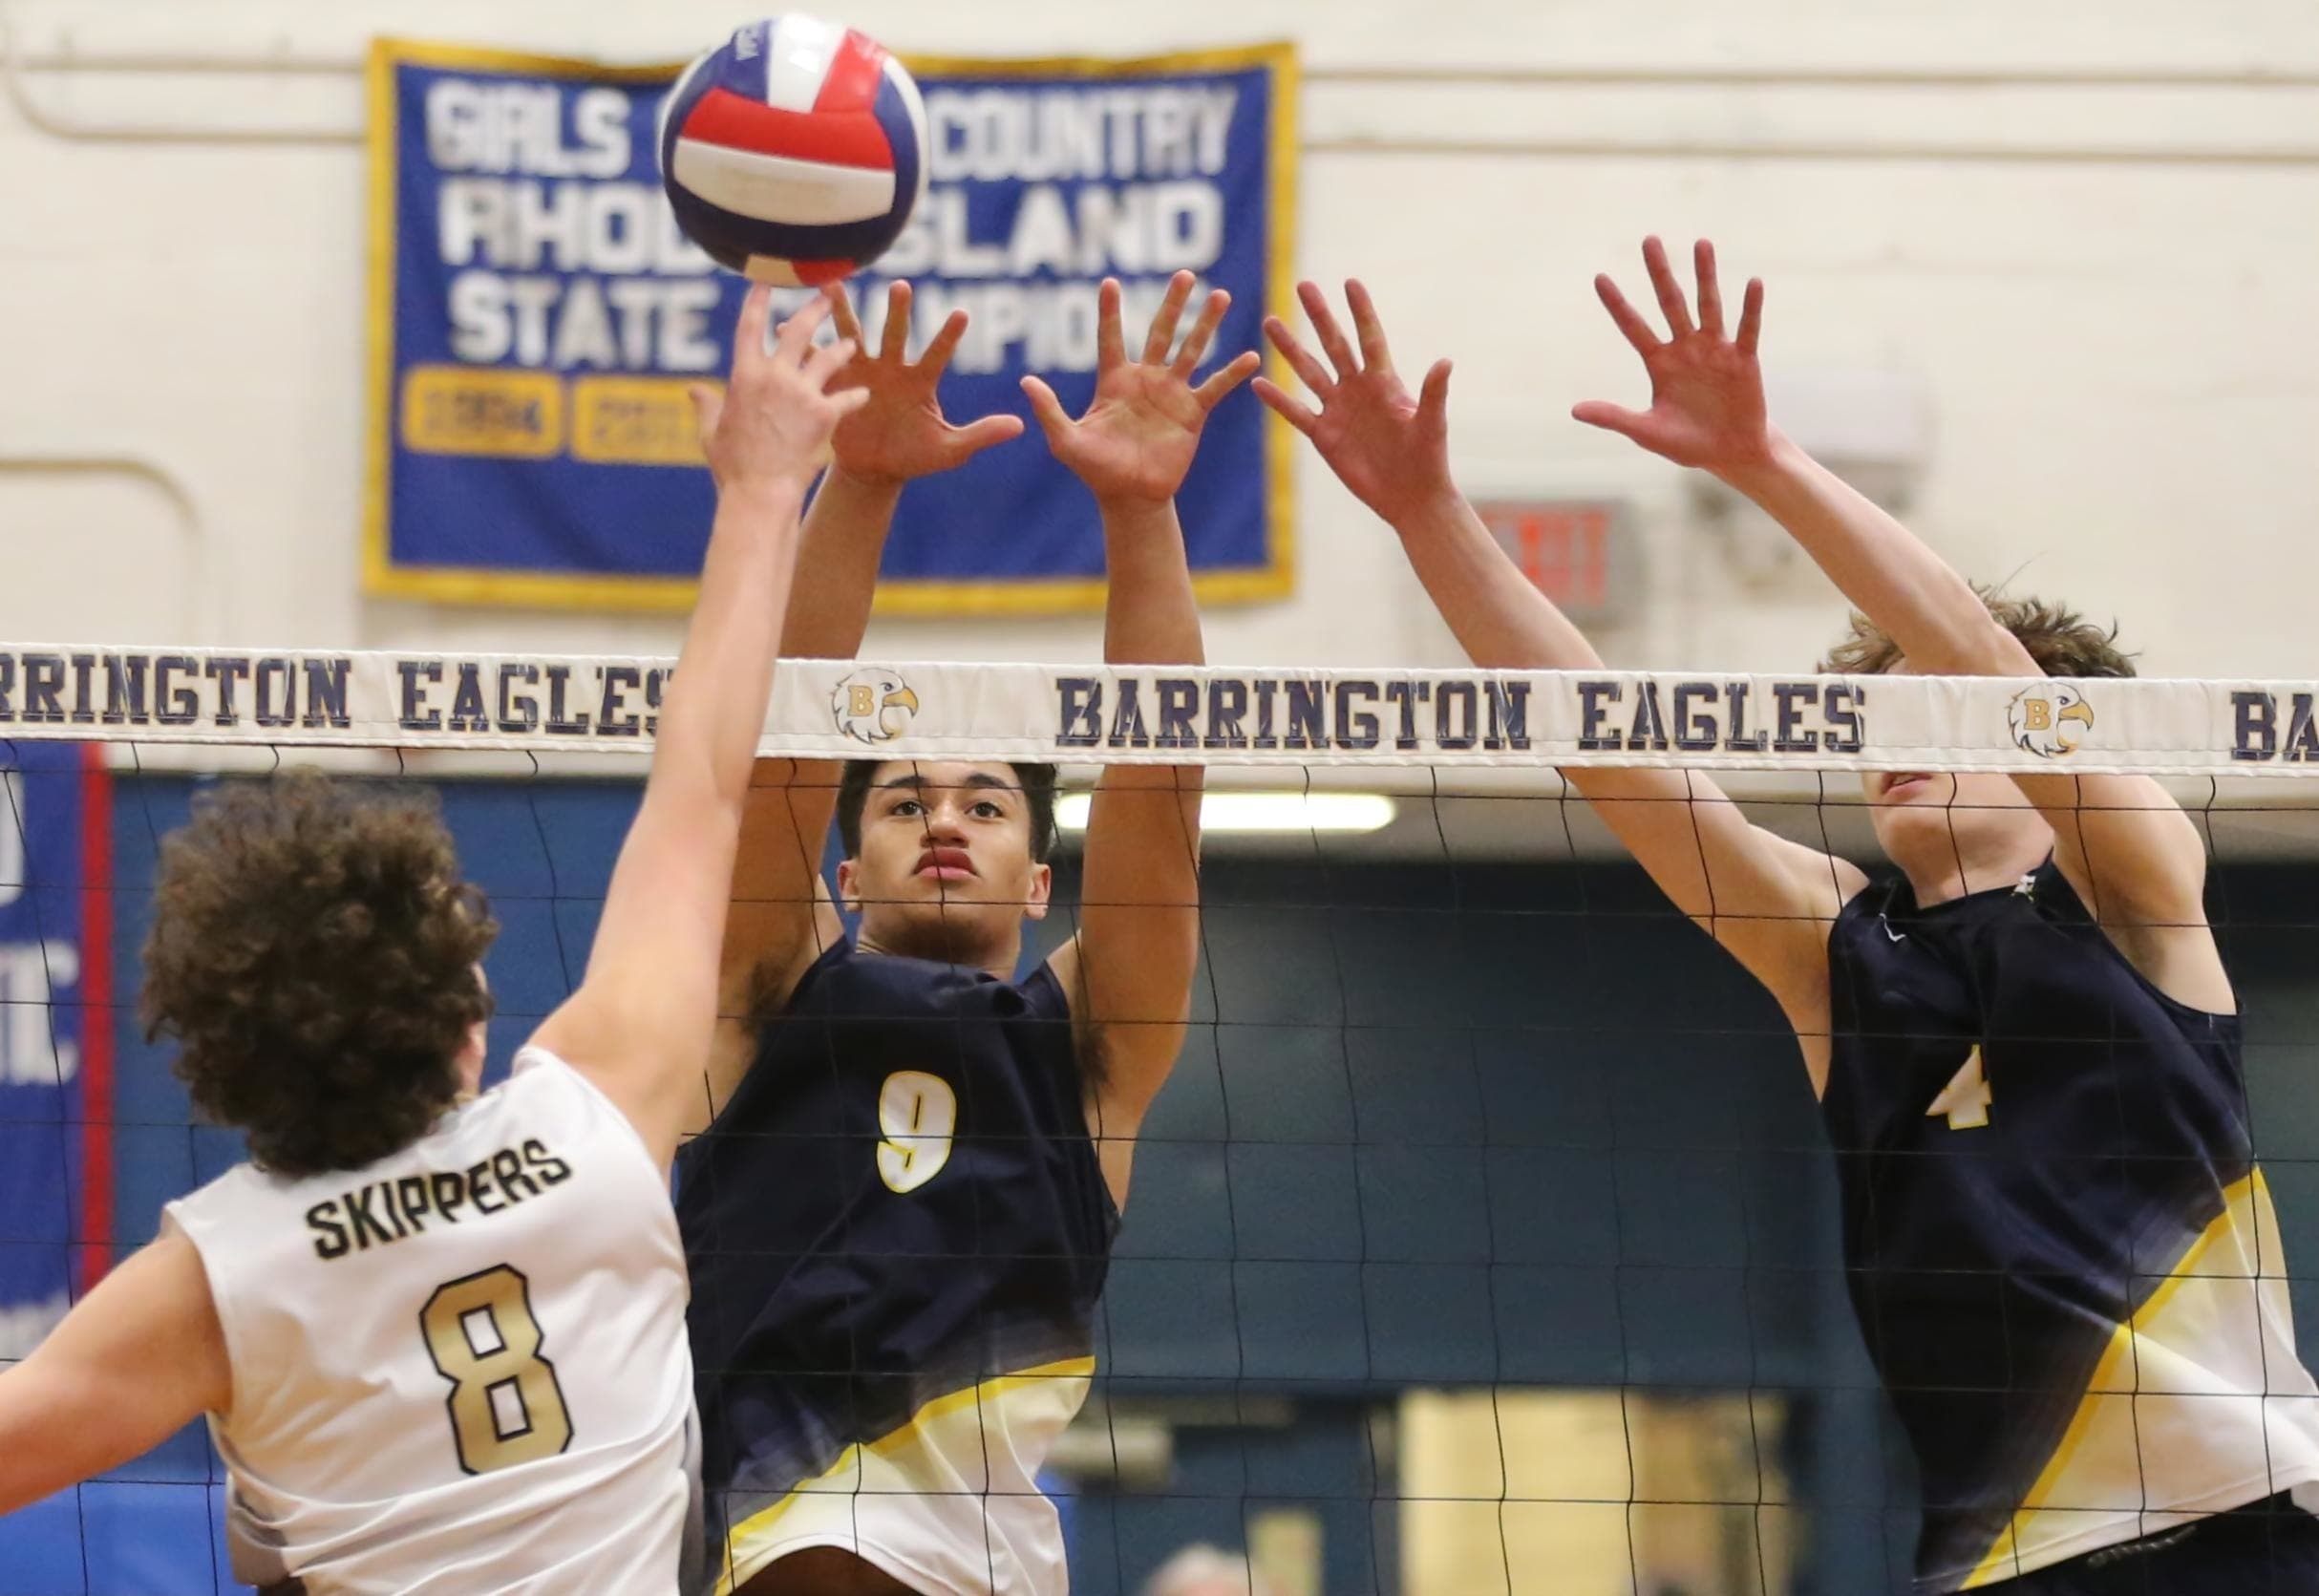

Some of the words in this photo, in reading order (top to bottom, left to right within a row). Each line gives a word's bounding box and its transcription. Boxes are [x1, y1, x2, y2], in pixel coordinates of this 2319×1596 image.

[426, 79, 631, 180] GIRLS
[925, 82, 1238, 182] COUNTRY
[449, 269, 721, 372] STATE
[846, 685, 874, 717] B
[1055, 676, 1530, 752] BARRINGTON
[1578, 682, 1865, 755] EAGLES
[2023, 698, 2051, 731] B
[877, 1070, 957, 1194] 9
[1925, 1043, 1992, 1130] 4
[305, 1138, 572, 1261] SKIPPERS
[418, 1262, 575, 1476] 8
